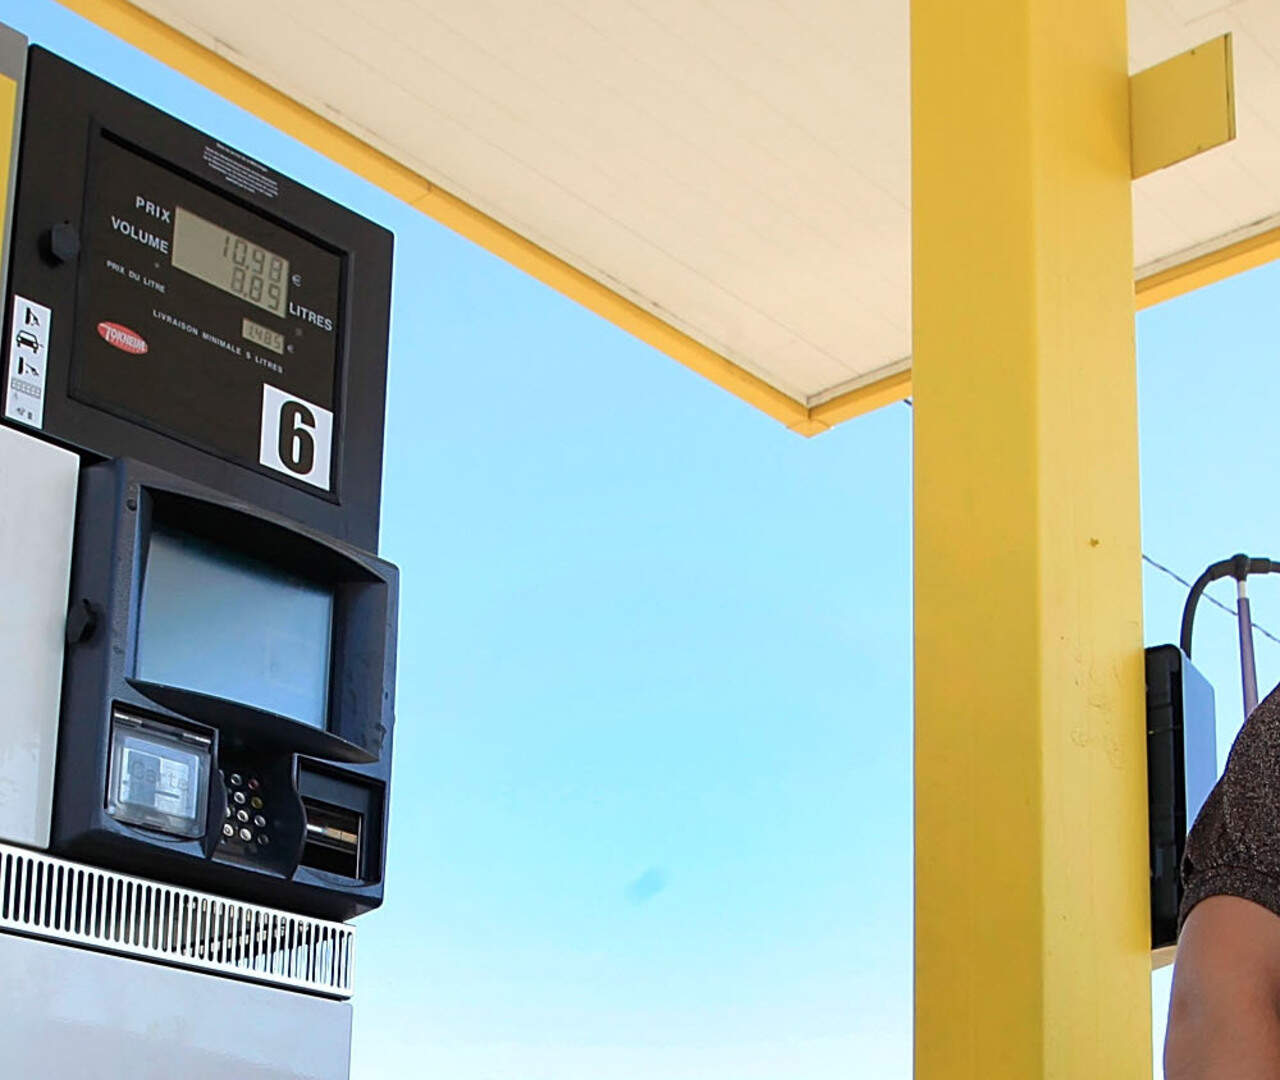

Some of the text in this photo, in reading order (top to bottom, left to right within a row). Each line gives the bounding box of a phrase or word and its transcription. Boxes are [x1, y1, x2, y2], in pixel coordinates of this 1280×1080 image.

[136, 196, 170, 224] PRIX
[111, 216, 169, 254] VOLUME
[106, 260, 166, 293] PRIX DU LITRE
[292, 274, 302, 287] €
[289, 302, 333, 332] LITRES
[152, 308, 198, 336] LIVRAISON
[202, 330, 241, 356] MINIMALE
[255, 355, 283, 374] LITRES
[278, 400, 317, 476] 6
